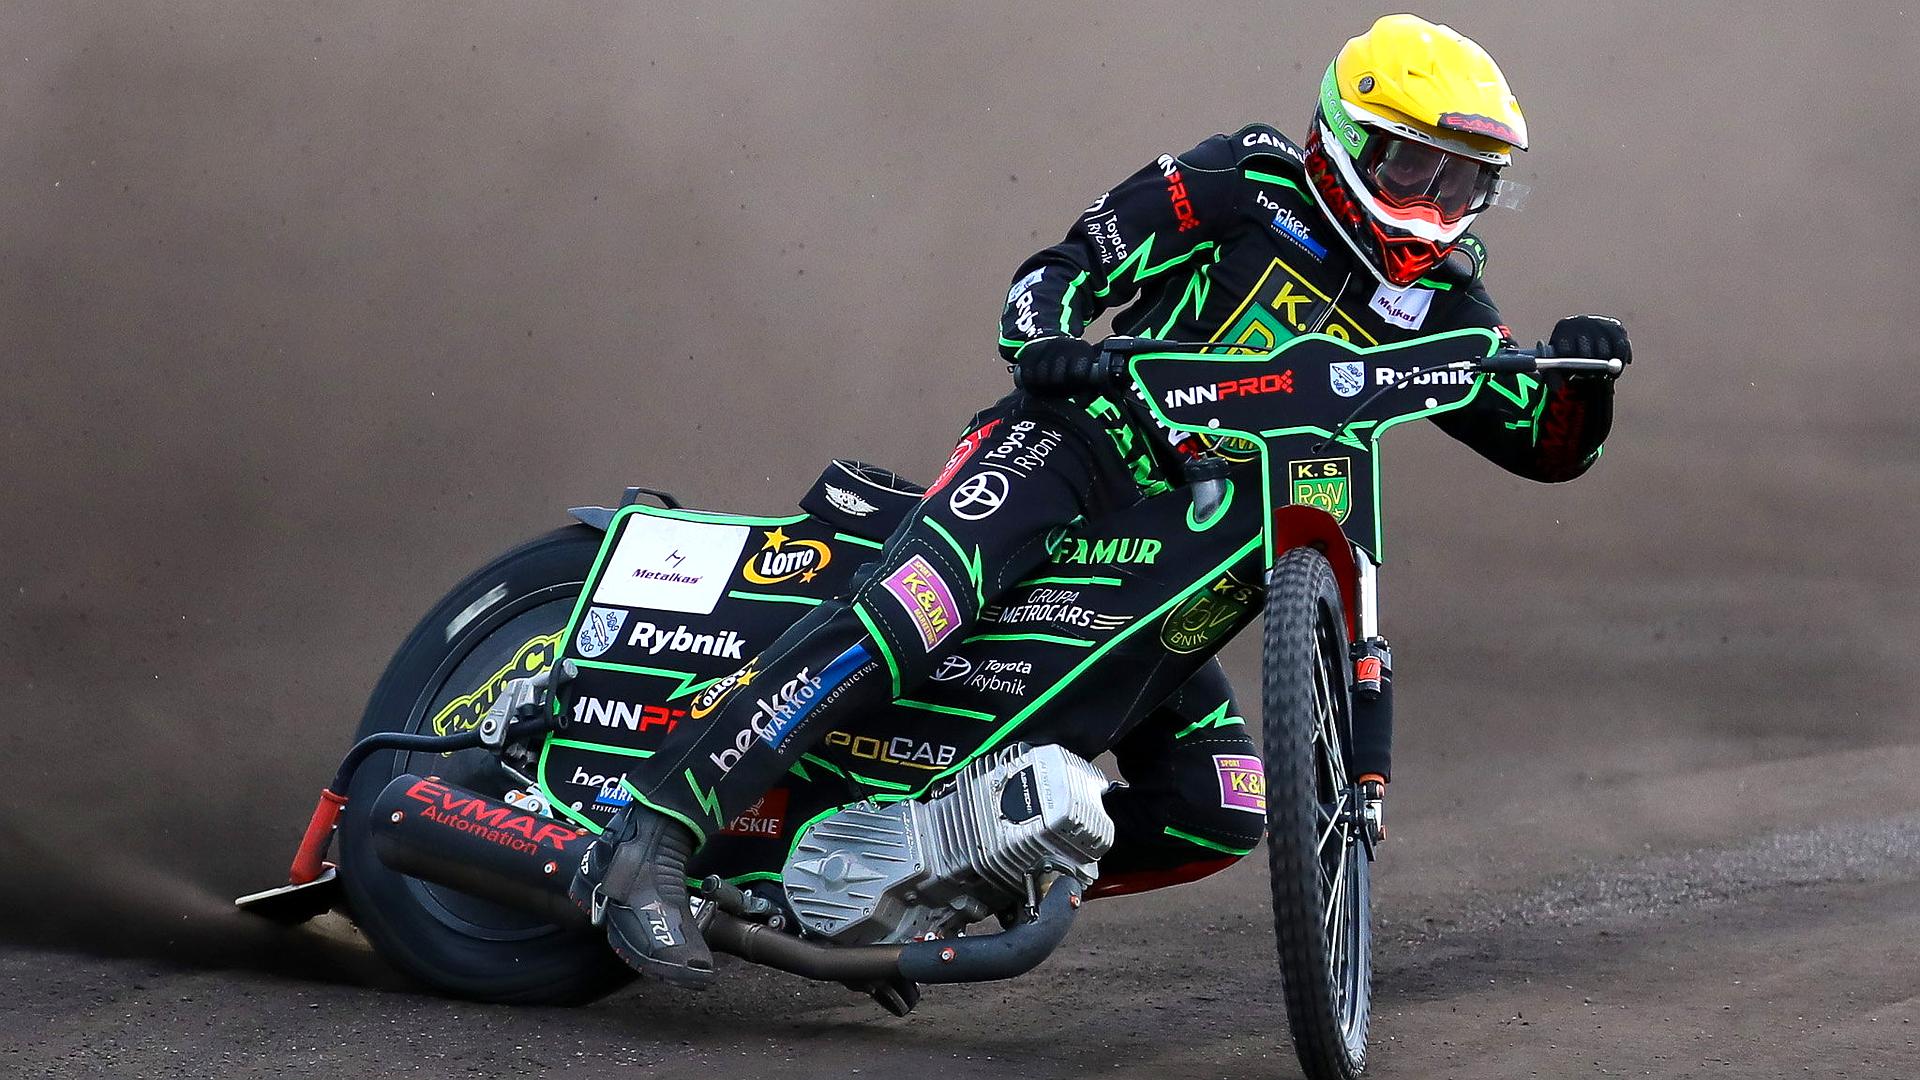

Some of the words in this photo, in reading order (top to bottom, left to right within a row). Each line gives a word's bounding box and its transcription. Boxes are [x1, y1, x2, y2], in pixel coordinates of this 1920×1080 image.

[1256, 190, 1311, 234] becker
[1087, 222, 1114, 265] Rybnik
[1104, 214, 1128, 261] Toyota
[1164, 373, 1283, 409] INNPRO
[1375, 366, 1476, 390] Rybnik
[984, 420, 1037, 460] Toyota
[760, 548, 815, 576] LOTTO
[1052, 538, 1162, 565] FAMUR
[631, 568, 701, 585] Metalkas
[901, 571, 949, 633] K&M
[1027, 588, 1080, 605] GRUPA
[998, 604, 1096, 628] METROCARS
[627, 621, 747, 660] Rybnik
[971, 674, 1027, 697] Rybnik
[984, 659, 1033, 675] Toyota
[709, 666, 812, 773] becker
[761, 675, 823, 743] WARKOP
[825, 730, 957, 767] POLCAB
[420, 805, 538, 856] Automation
